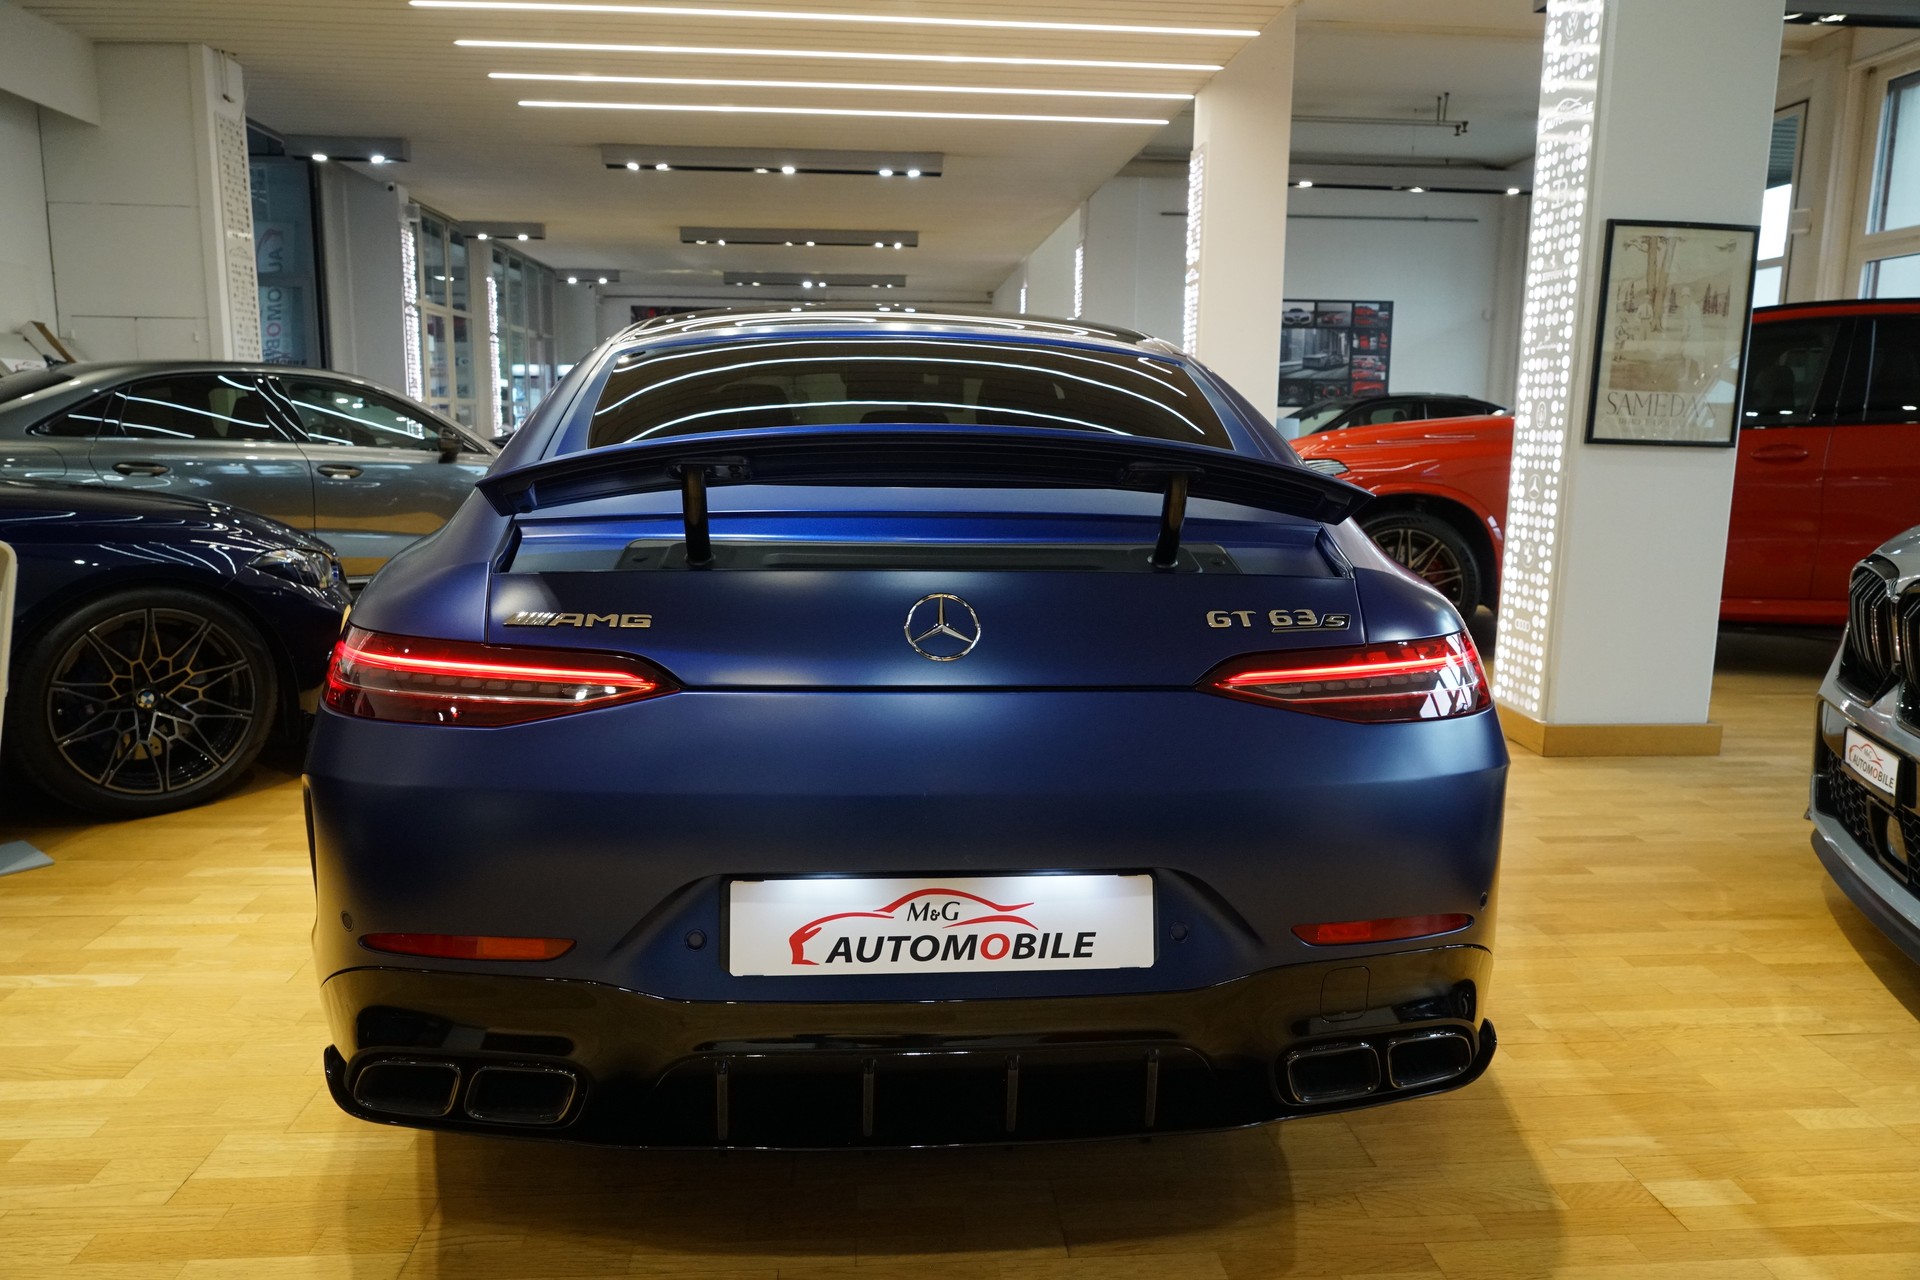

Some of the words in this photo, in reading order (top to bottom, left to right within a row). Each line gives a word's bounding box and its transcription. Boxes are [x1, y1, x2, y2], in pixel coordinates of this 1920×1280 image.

[547, 612, 653, 628] AMG
[1206, 610, 1257, 628] GT
[1853, 754, 1895, 789] AUTOMOBILE
[906, 901, 961, 922] M&G
[825, 931, 1097, 964] AUTOMOBILE
